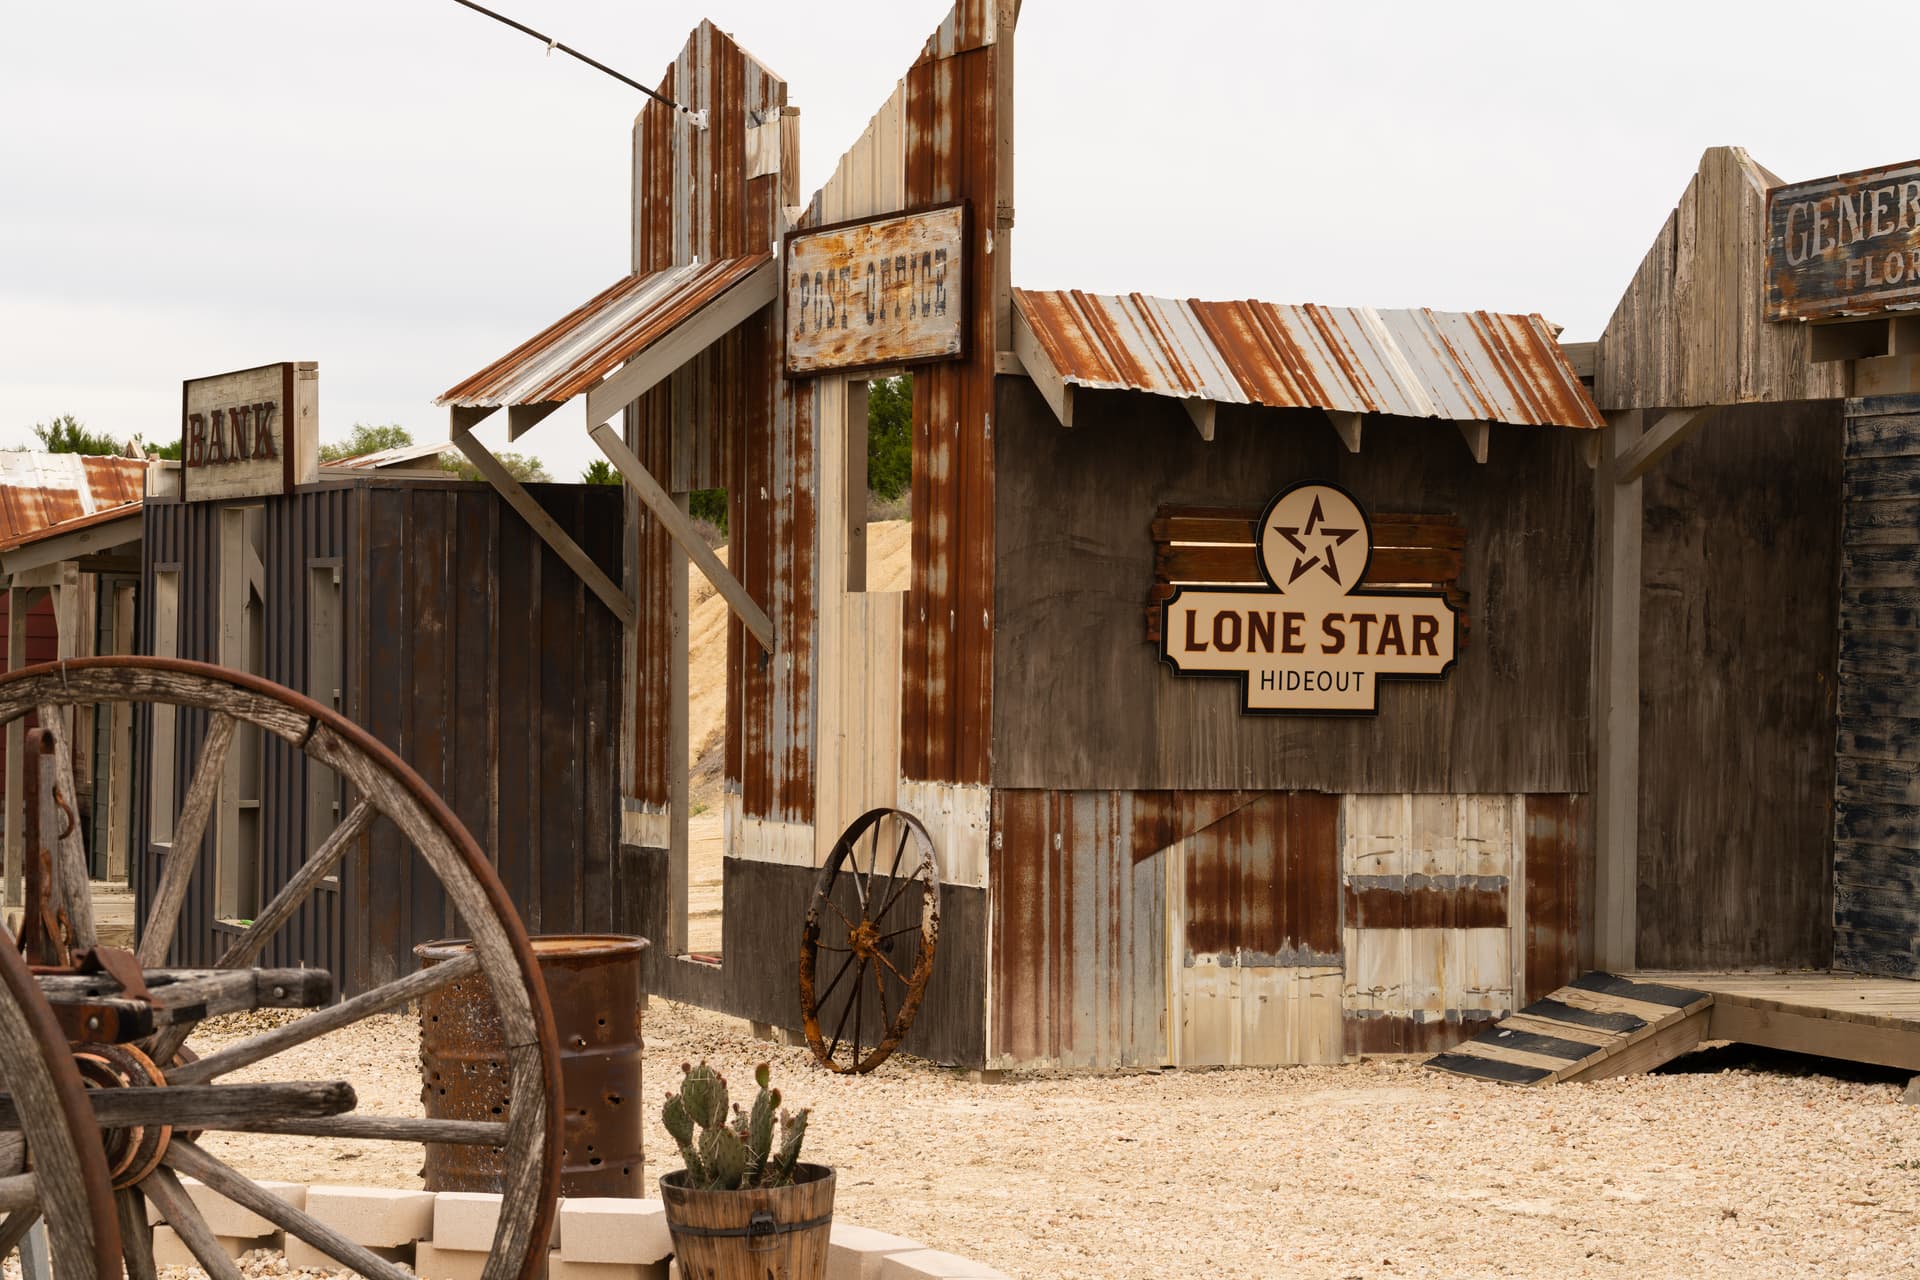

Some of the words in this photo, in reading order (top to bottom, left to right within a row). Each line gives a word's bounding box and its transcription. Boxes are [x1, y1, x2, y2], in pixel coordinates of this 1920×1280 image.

[1784, 180, 1920, 267] GENER
[799, 264, 851, 334] POST
[866, 248, 948, 326] OFFICE
[187, 401, 276, 468] BANK
[1184, 609, 1307, 654] LONE
[1320, 612, 1440, 656] STAR
[1260, 669, 1365, 692] HIDEOUT
